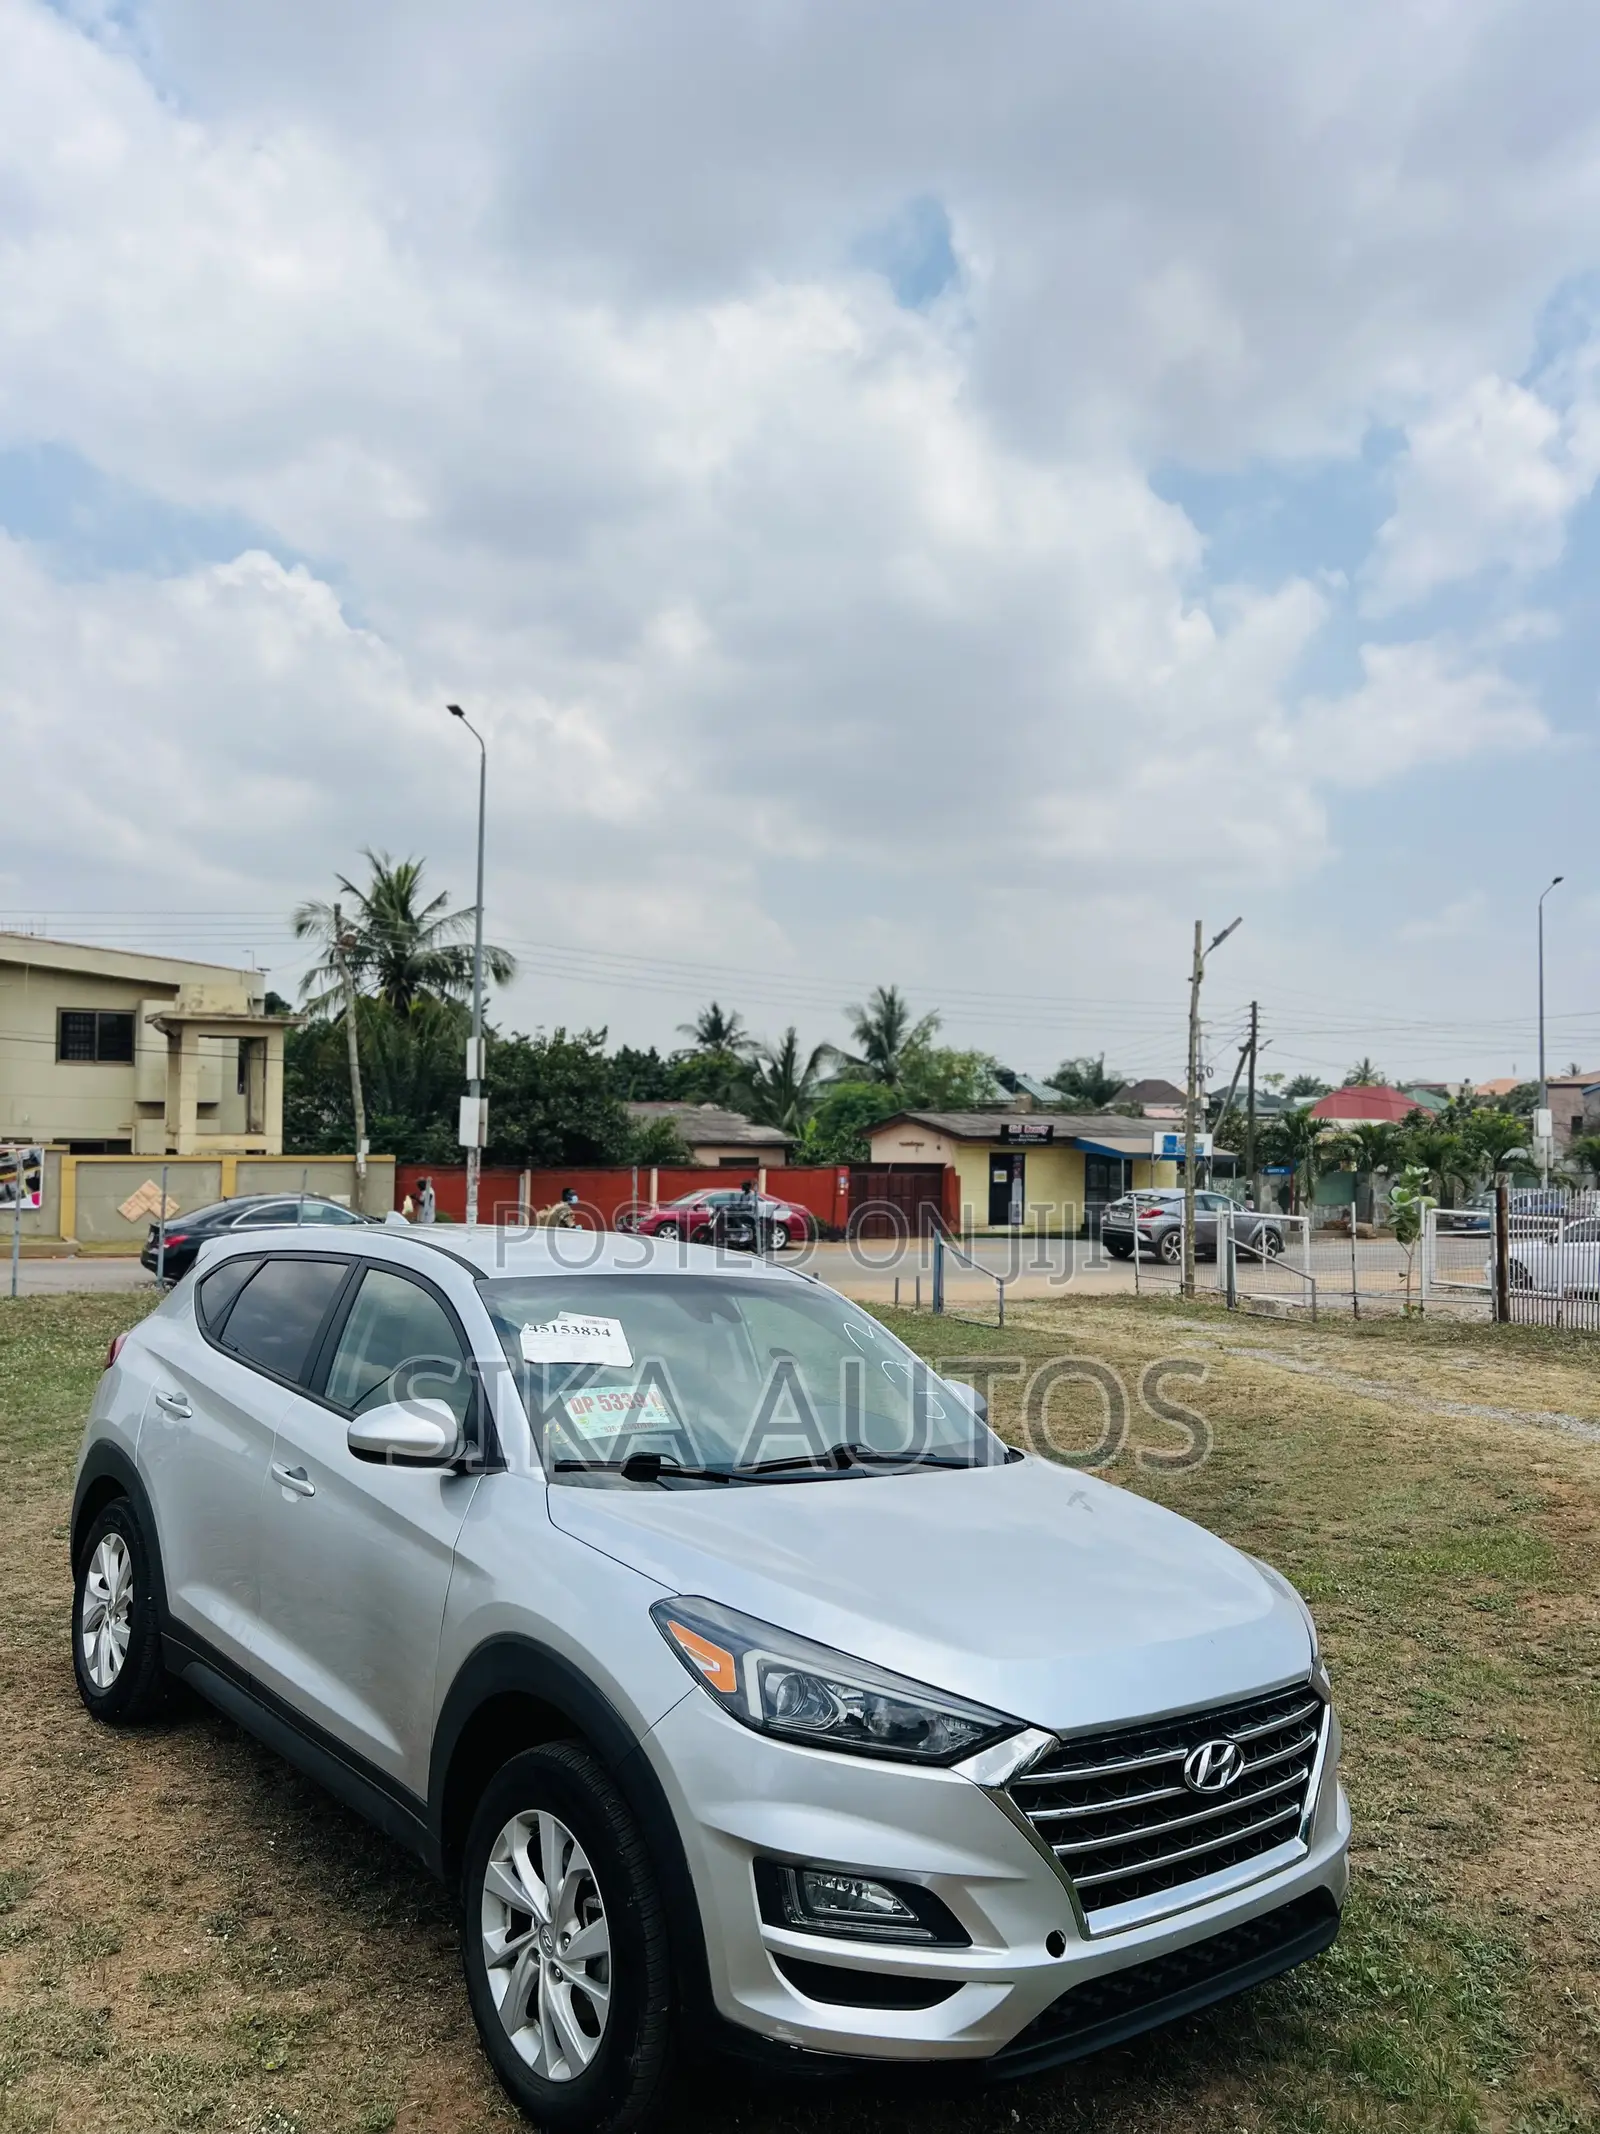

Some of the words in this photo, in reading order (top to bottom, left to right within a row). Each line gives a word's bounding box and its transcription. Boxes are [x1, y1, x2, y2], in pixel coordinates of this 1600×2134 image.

[528, 1324, 611, 1338] 45153834
[568, 1396, 594, 1415] DP
[596, 1391, 648, 1412] 5339
